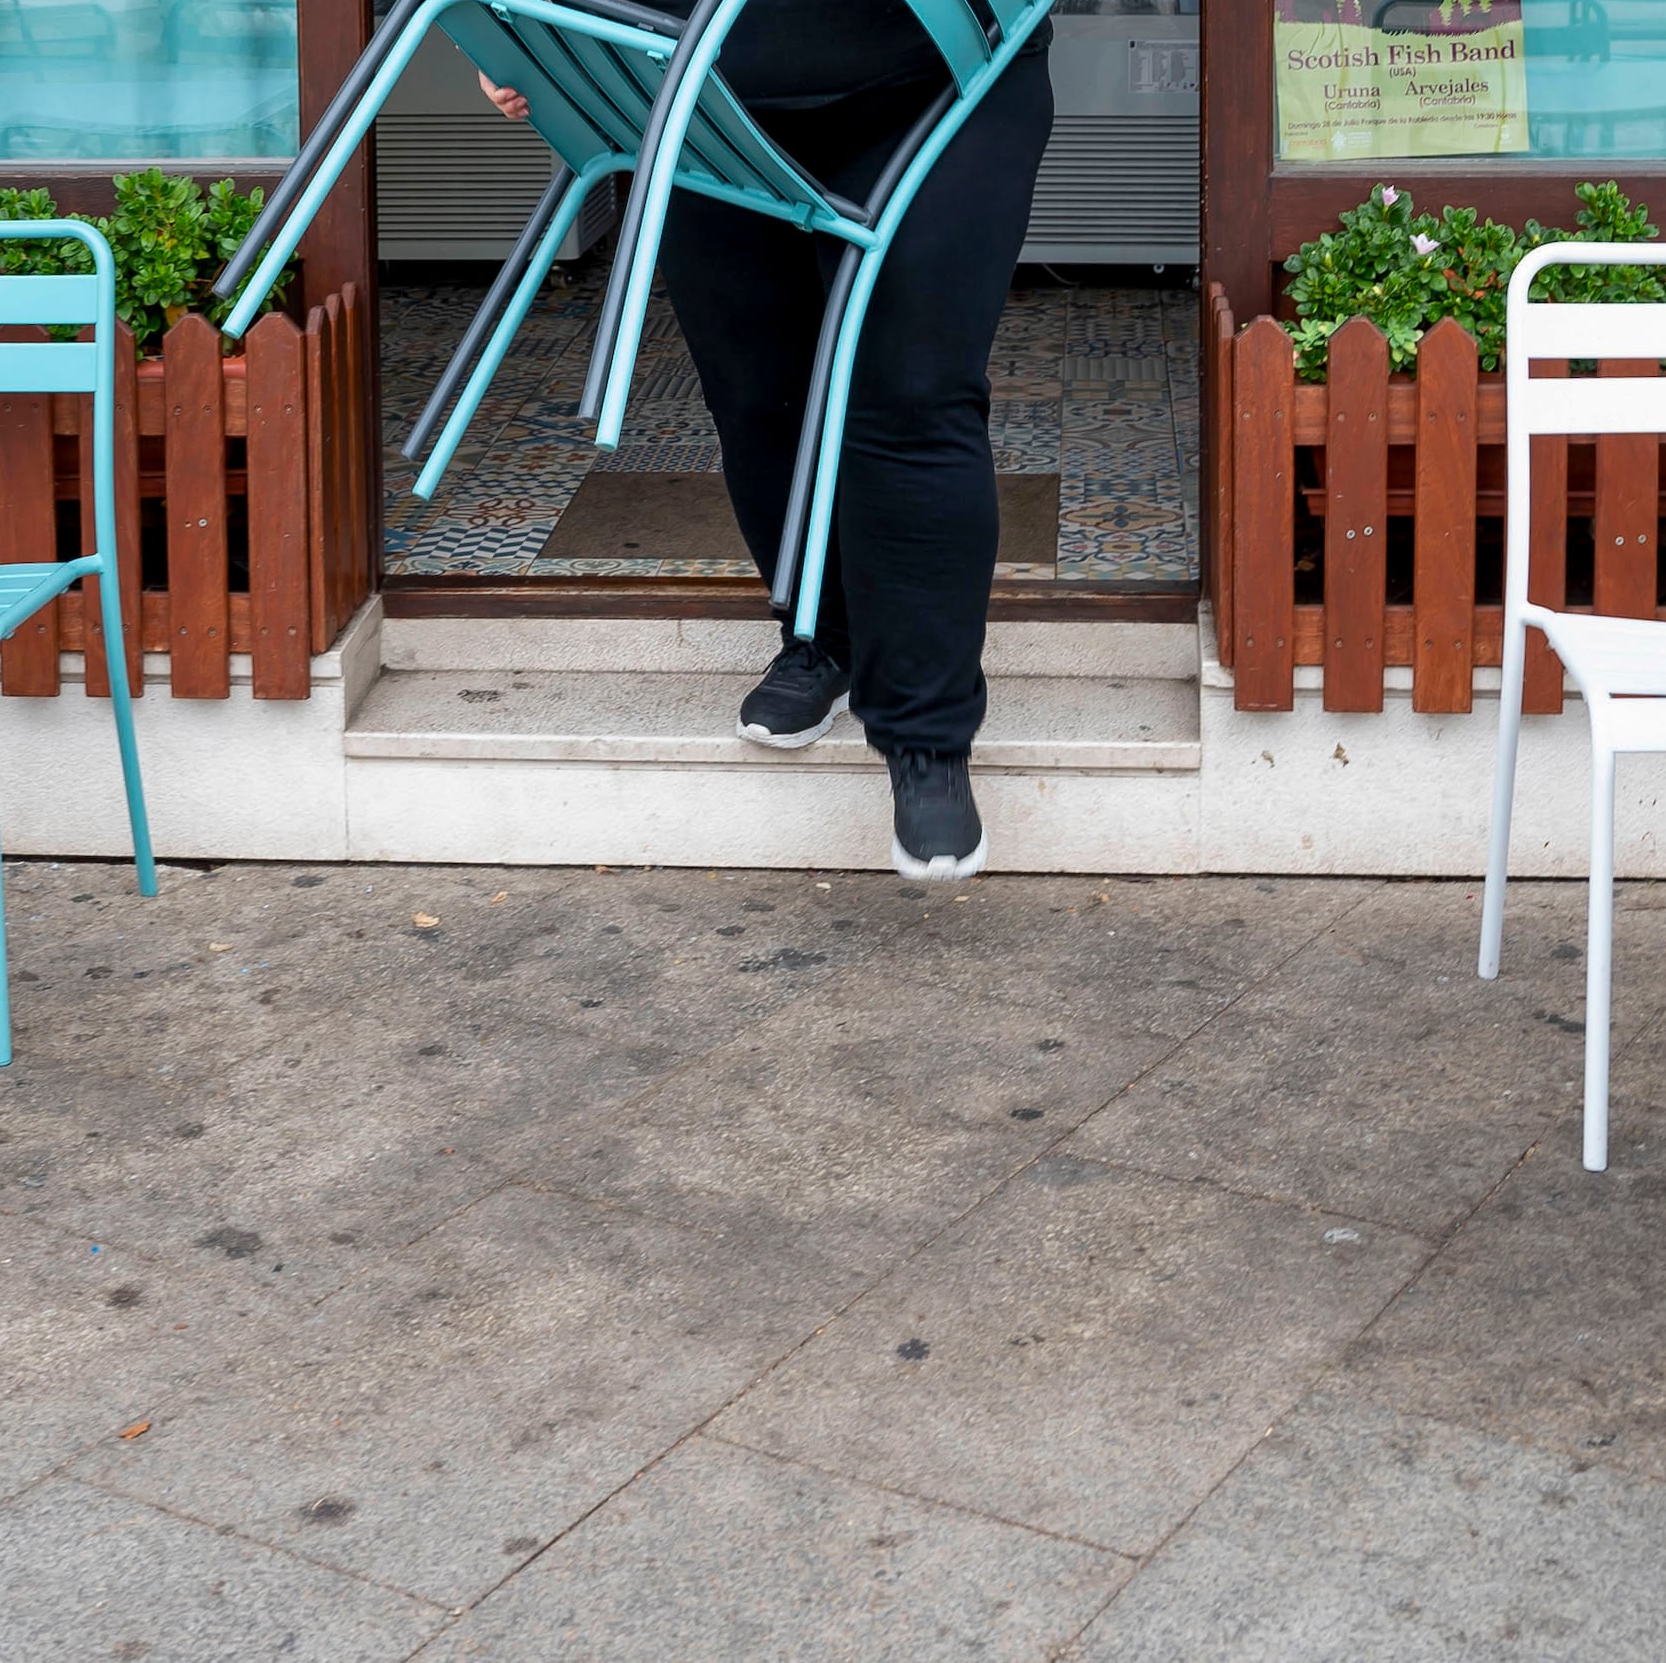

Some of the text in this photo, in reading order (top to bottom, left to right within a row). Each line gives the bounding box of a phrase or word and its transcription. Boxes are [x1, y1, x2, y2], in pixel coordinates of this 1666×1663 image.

[1287, 39, 1516, 71] Scotish Fish Band
[1389, 66, 1417, 79] (USA)
[1324, 78, 1489, 100] Uruna Arvejales
[1325, 95, 1476, 113] (Cantabria) (Cantabria)
[1288, 120, 1321, 130] Domingo
